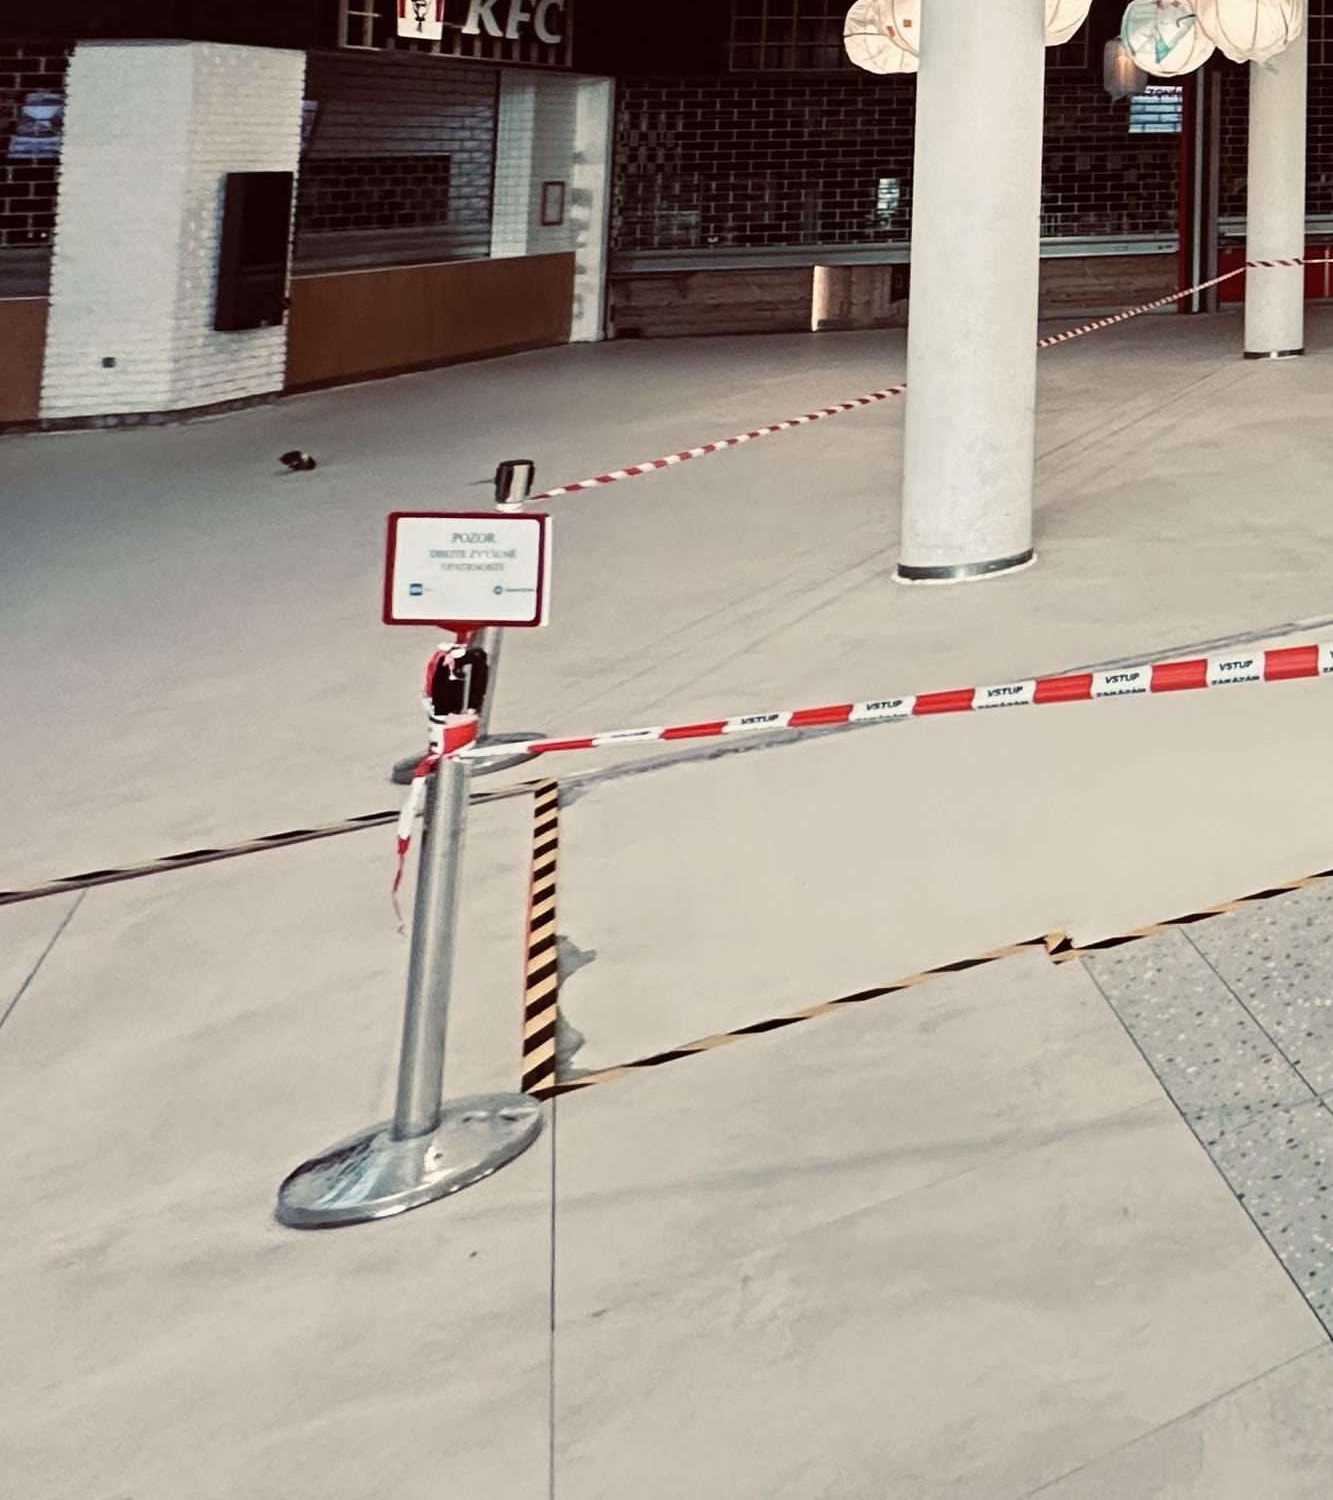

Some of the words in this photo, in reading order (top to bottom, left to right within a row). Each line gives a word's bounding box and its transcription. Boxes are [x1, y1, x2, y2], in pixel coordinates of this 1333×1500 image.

[452, 532, 496, 543] POZOR
[1219, 660, 1253, 671] VSTUP
[1105, 673, 1140, 684] VSTUP
[987, 686, 1024, 697] VSTUP
[866, 700, 903, 711] VSTUP
[741, 714, 779, 725] VSTUP
